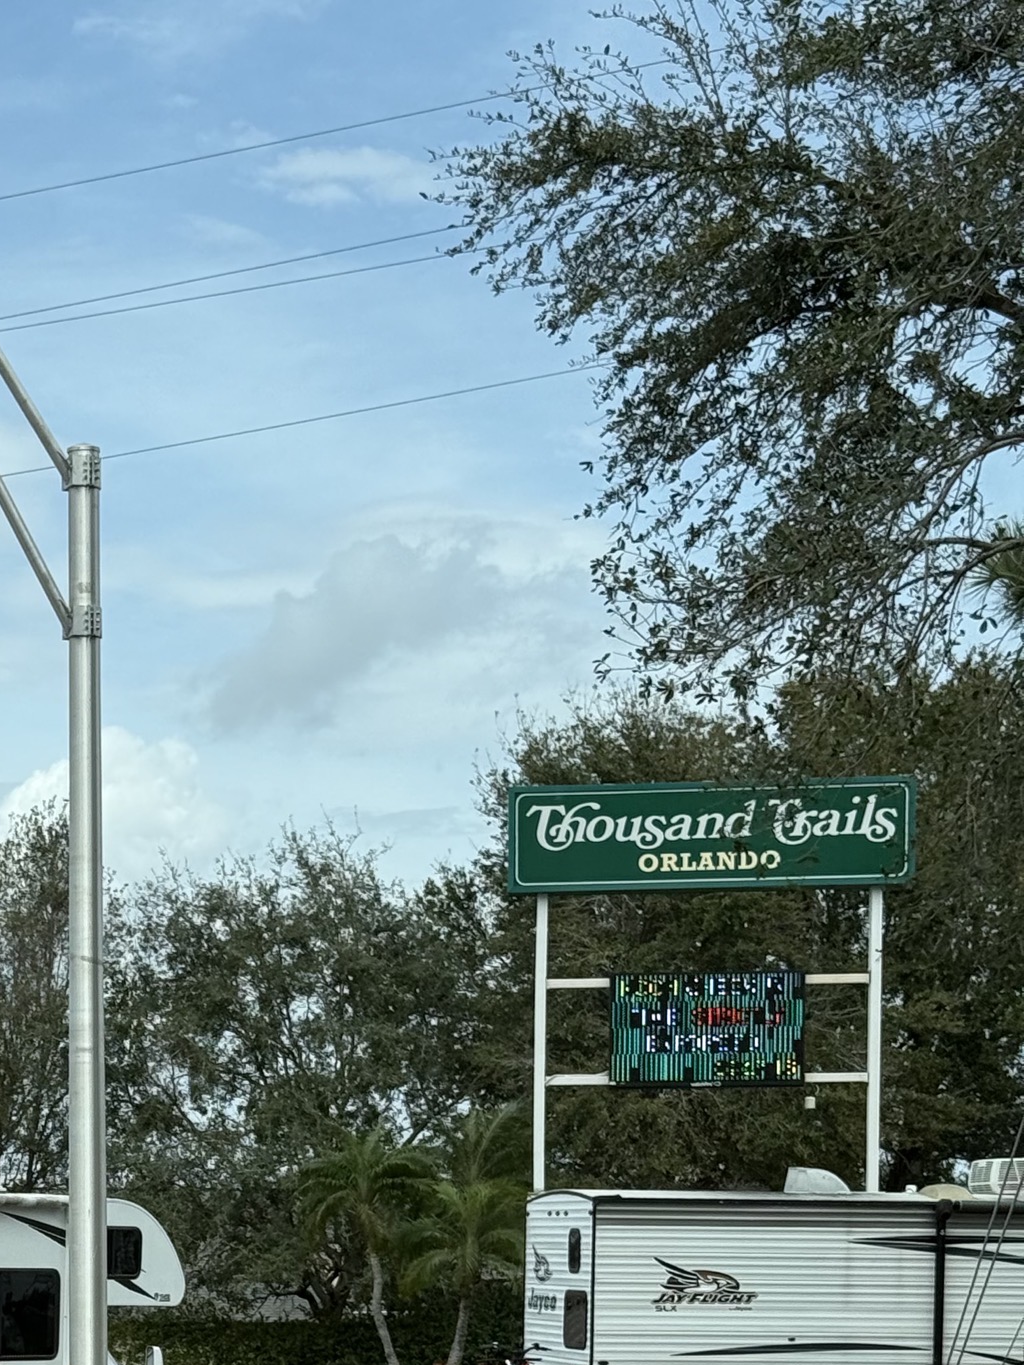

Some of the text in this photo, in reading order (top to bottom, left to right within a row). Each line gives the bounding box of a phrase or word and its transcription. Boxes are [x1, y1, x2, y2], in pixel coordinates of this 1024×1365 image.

[526, 794, 898, 851] Thousand Trails
[638, 850, 781, 873] ORLANDO
[528, 1287, 557, 1314] Jayco
